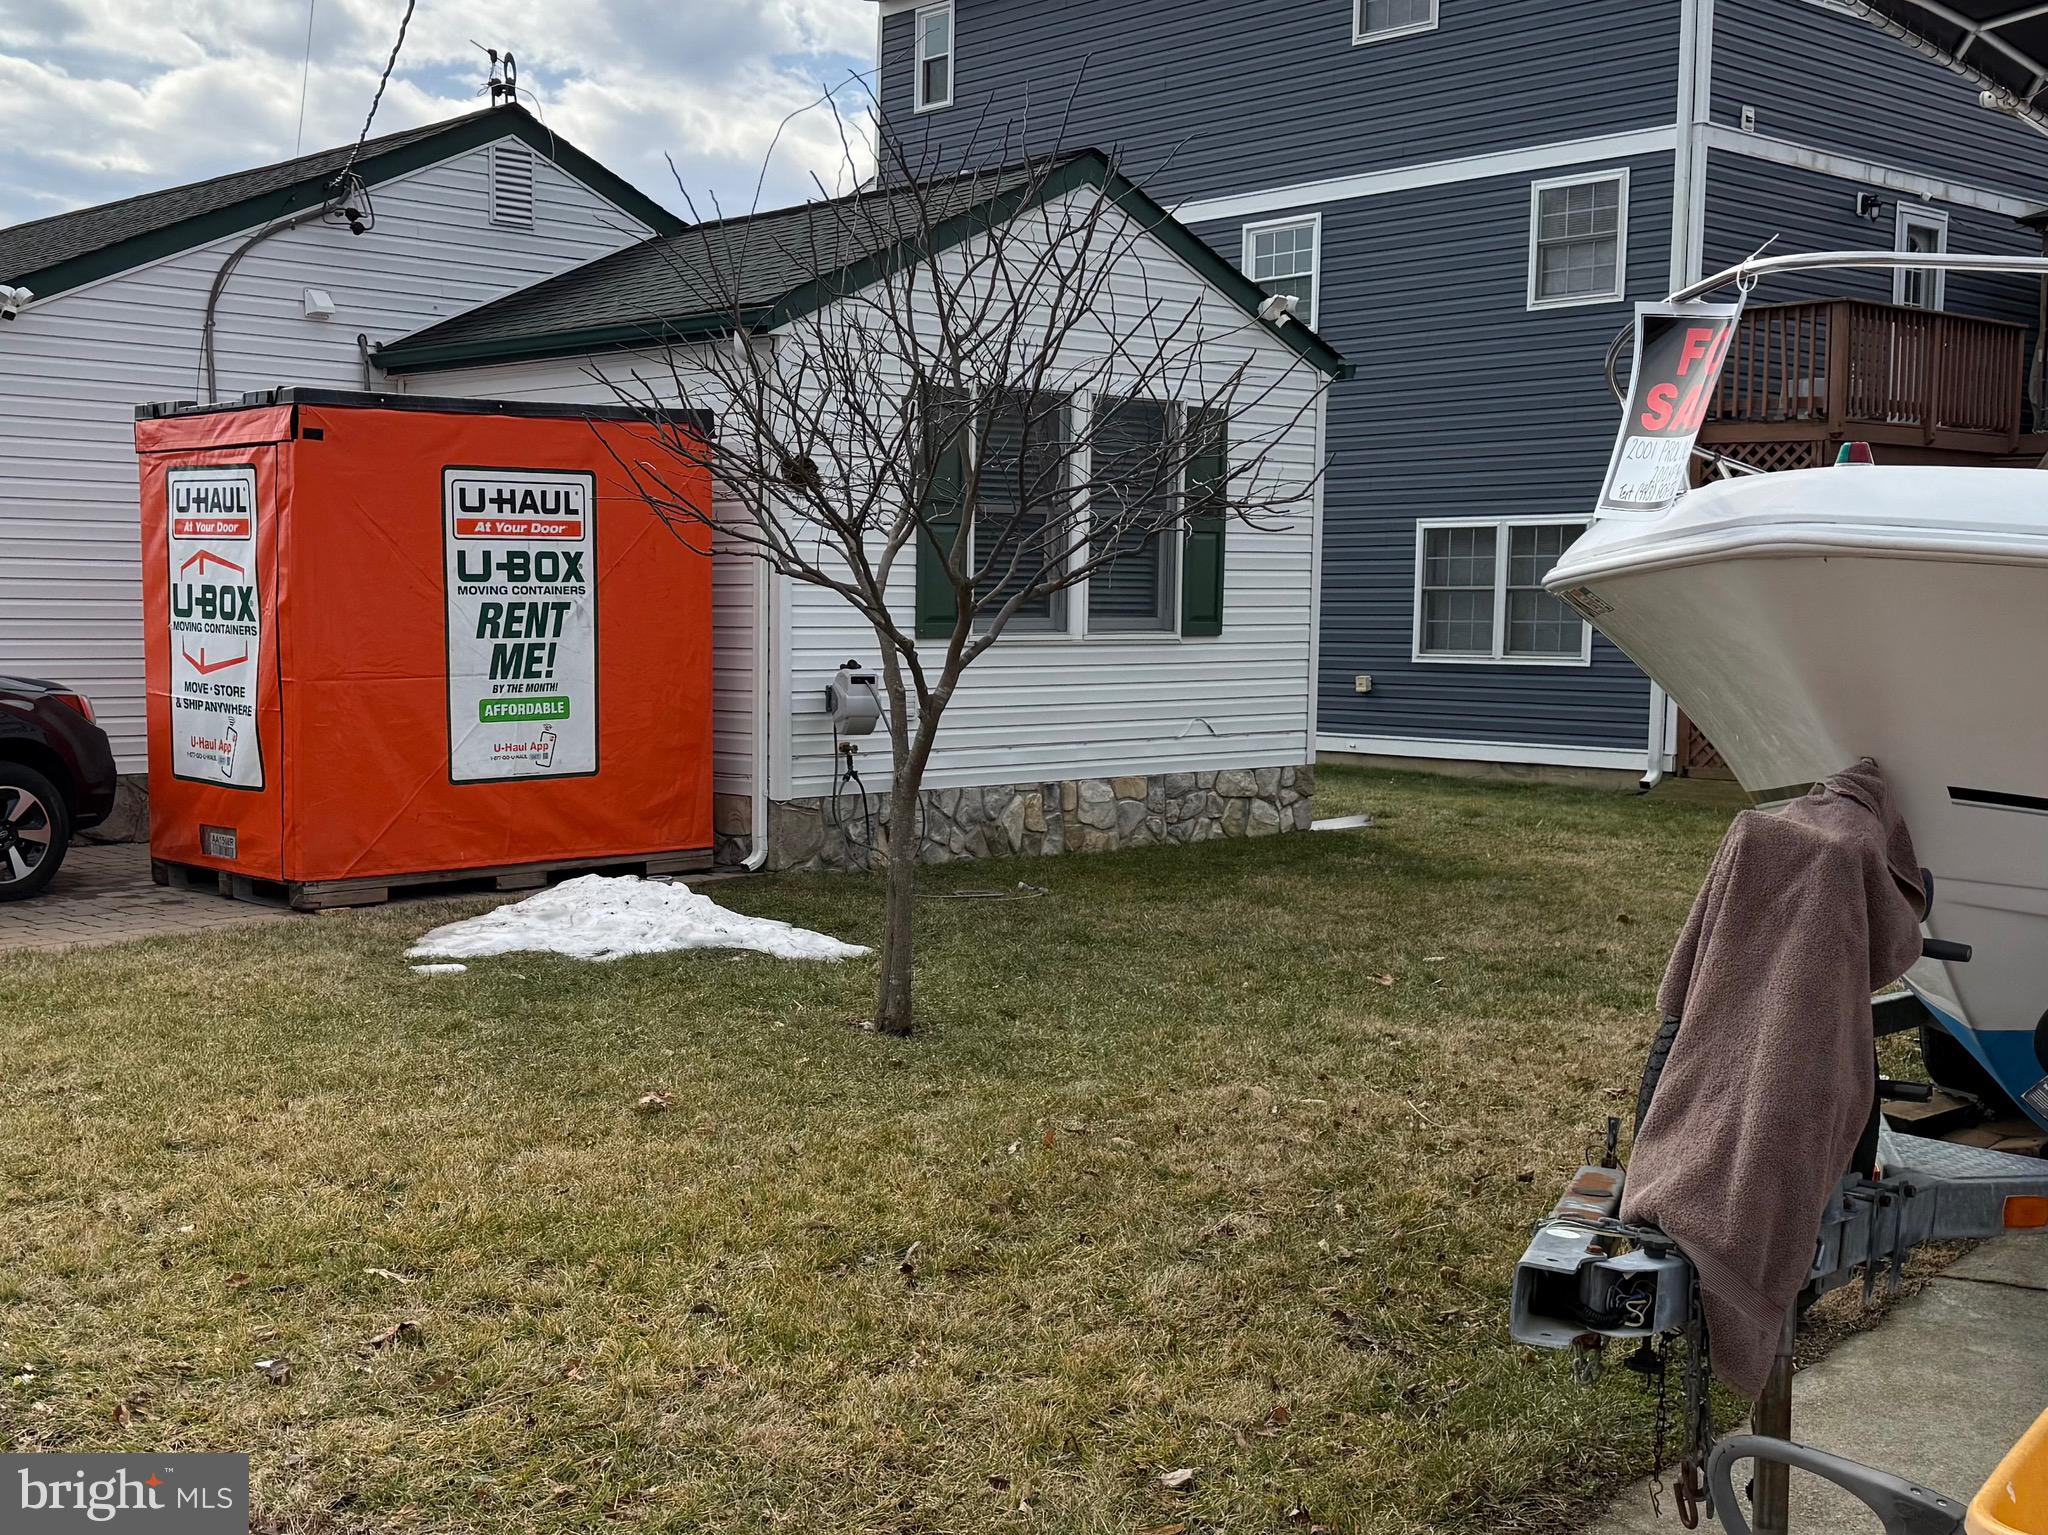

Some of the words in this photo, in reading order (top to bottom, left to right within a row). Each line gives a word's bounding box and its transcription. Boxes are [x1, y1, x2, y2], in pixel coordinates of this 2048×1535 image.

[1676, 327, 1731, 376] FO
[1641, 383, 1714, 431] SA
[1626, 438, 1658, 460] 2001
[176, 487, 247, 513] U-HAUL
[459, 488, 579, 515] U-HAUL
[183, 521, 193, 532] At
[195, 521, 215, 532] Your
[217, 522, 240, 532] Door
[474, 522, 492, 533] At
[495, 522, 528, 533] Your
[531, 523, 566, 533] Door
[457, 550, 585, 583] U-BOX
[457, 586, 508, 595] MOVING
[511, 586, 586, 595] CONTAINERS
[173, 583, 256, 622] U-BOX
[173, 621, 202, 633] MOVING
[204, 623, 258, 636] CONTAINERS
[475, 602, 572, 639] RENT
[488, 642, 557, 680] ME!
[184, 681, 209, 694] MOVE
[214, 684, 246, 698] STORE
[492, 684, 505, 694] BY
[507, 684, 524, 693] THE
[525, 683, 558, 693] MONTH!
[175, 697, 182, 708] &
[183, 698, 204, 710] SHIP
[204, 701, 253, 717] ANYWHERE
[485, 702, 565, 717] AFFORDABLE
[190, 735, 217, 751] U-Haul
[218, 739, 232, 754] App
[494, 742, 527, 753] U-Haul
[530, 742, 549, 752] App
